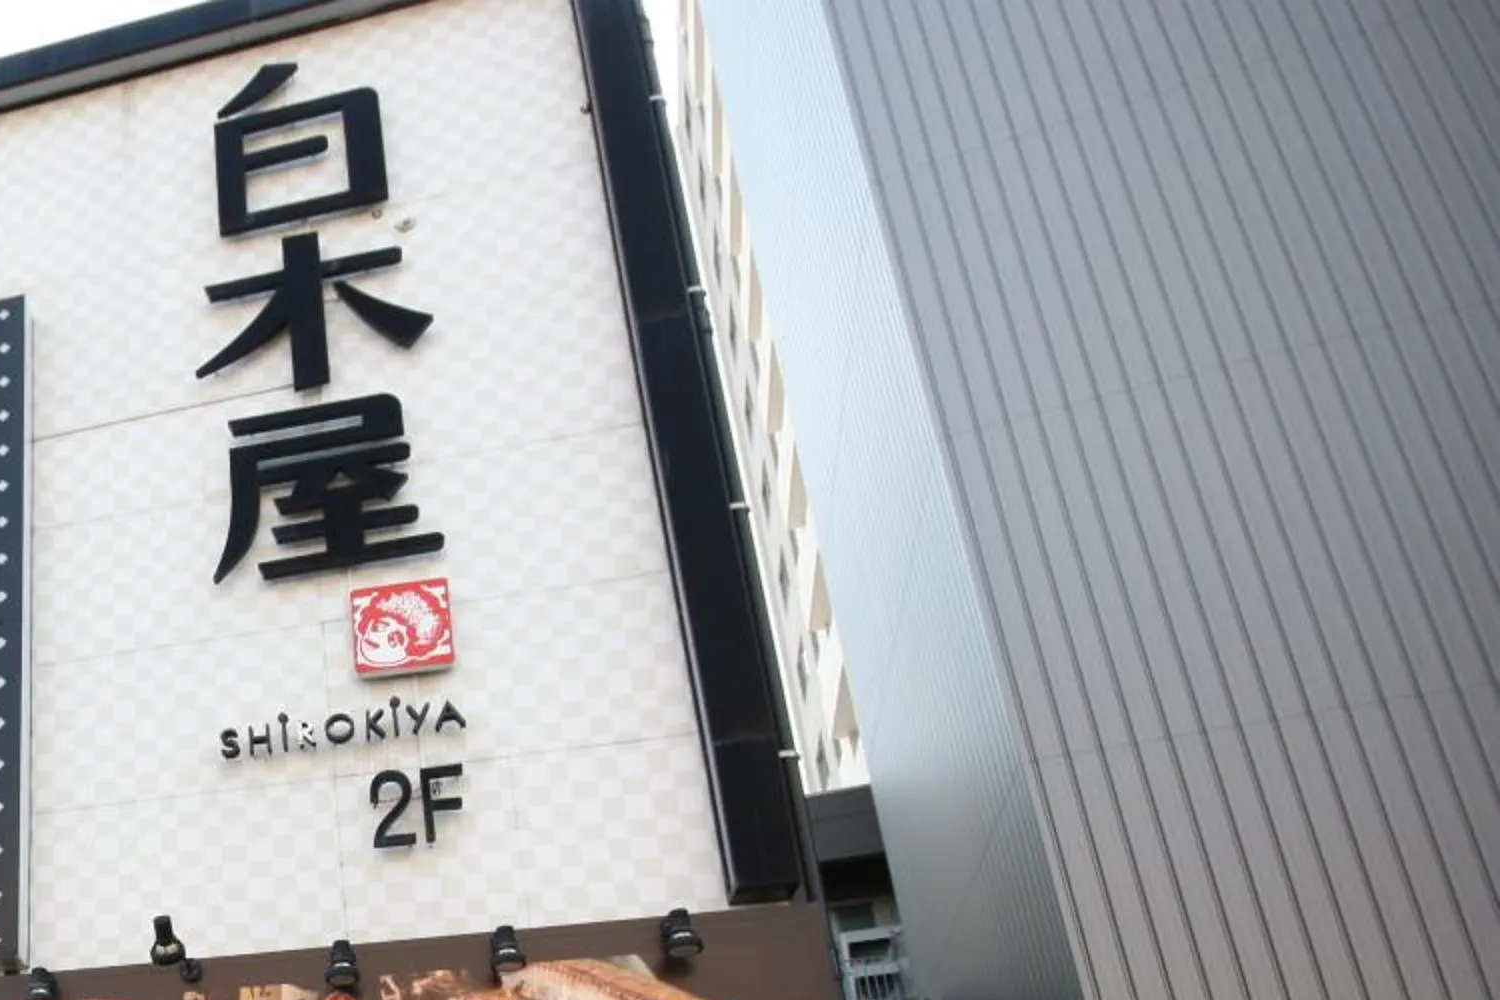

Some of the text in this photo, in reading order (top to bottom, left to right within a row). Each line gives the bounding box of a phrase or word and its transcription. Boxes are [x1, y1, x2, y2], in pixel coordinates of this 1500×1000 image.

[195, 62, 445, 584] 白木屋
[369, 763, 464, 849] 2F
